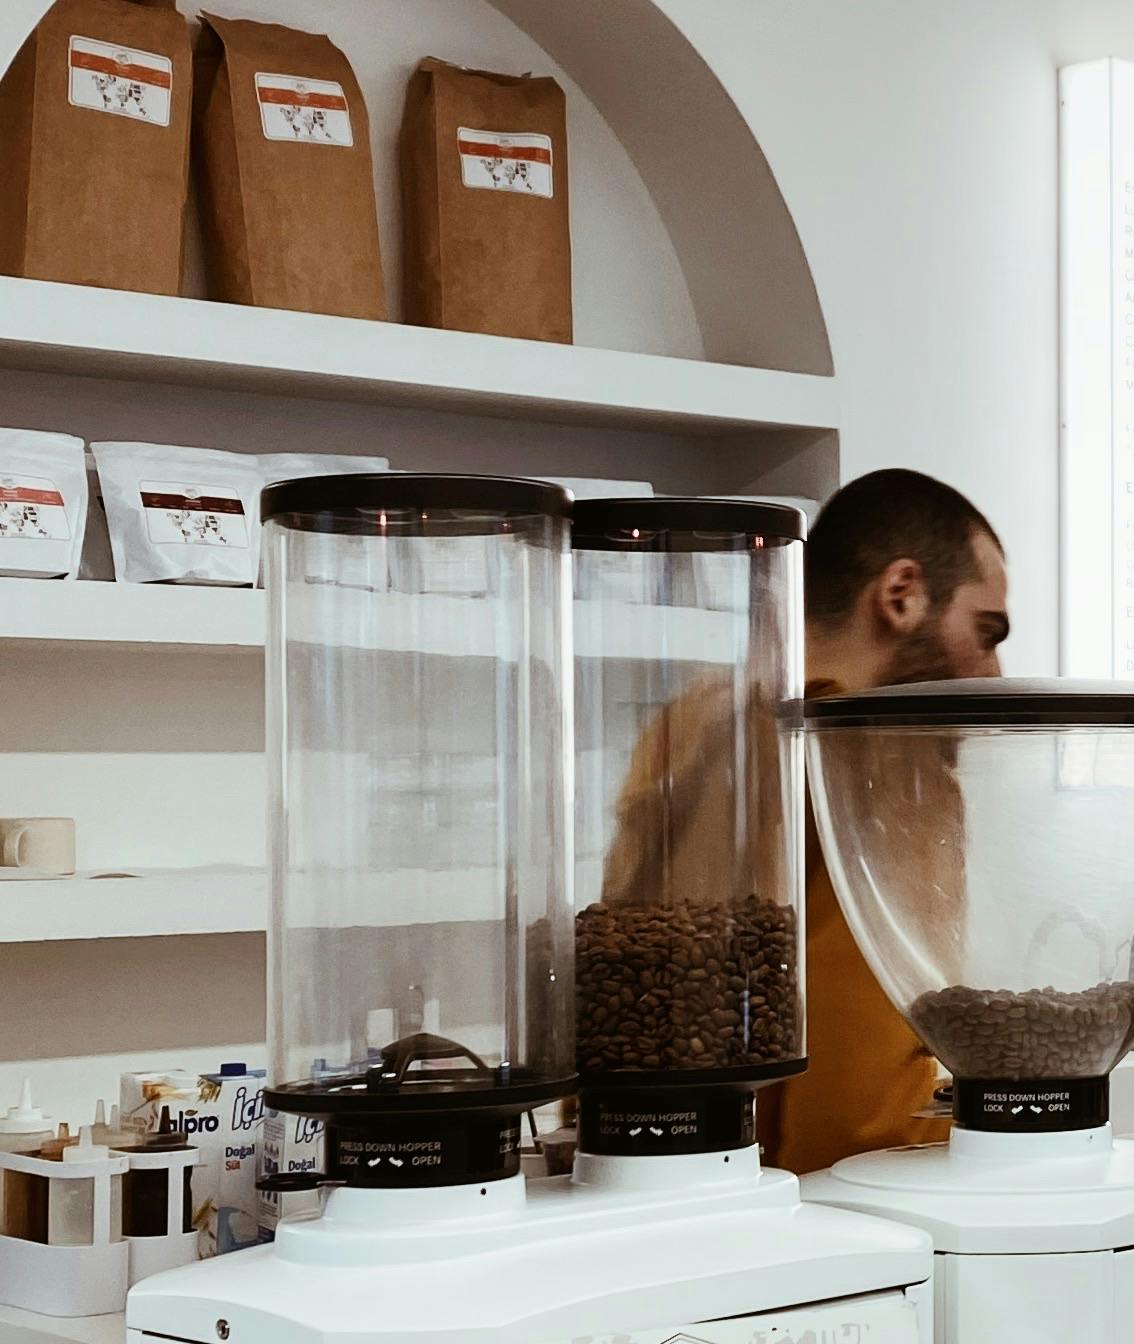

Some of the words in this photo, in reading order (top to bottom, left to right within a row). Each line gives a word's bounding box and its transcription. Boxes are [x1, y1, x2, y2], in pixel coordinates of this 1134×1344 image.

[984, 1092, 1008, 1102] PRESS
[1009, 1093, 1036, 1102] DOWN
[1037, 1092, 1070, 1102] HOPPER
[983, 1103, 1004, 1113] LOCK
[1048, 1103, 1071, 1113] OPEN
[600, 1112, 625, 1122] PRESS
[626, 1113, 657, 1123] DOWN
[658, 1111, 697, 1123] HOPPER
[670, 1125, 698, 1135] OPEN
[339, 1140, 363, 1152] PRESS
[365, 1141, 396, 1152] DOWN
[398, 1141, 442, 1152] HOPPER
[225, 1144, 255, 1160] Doğal
[339, 1155, 360, 1165] LOCK
[411, 1155, 442, 1166] OPEN
